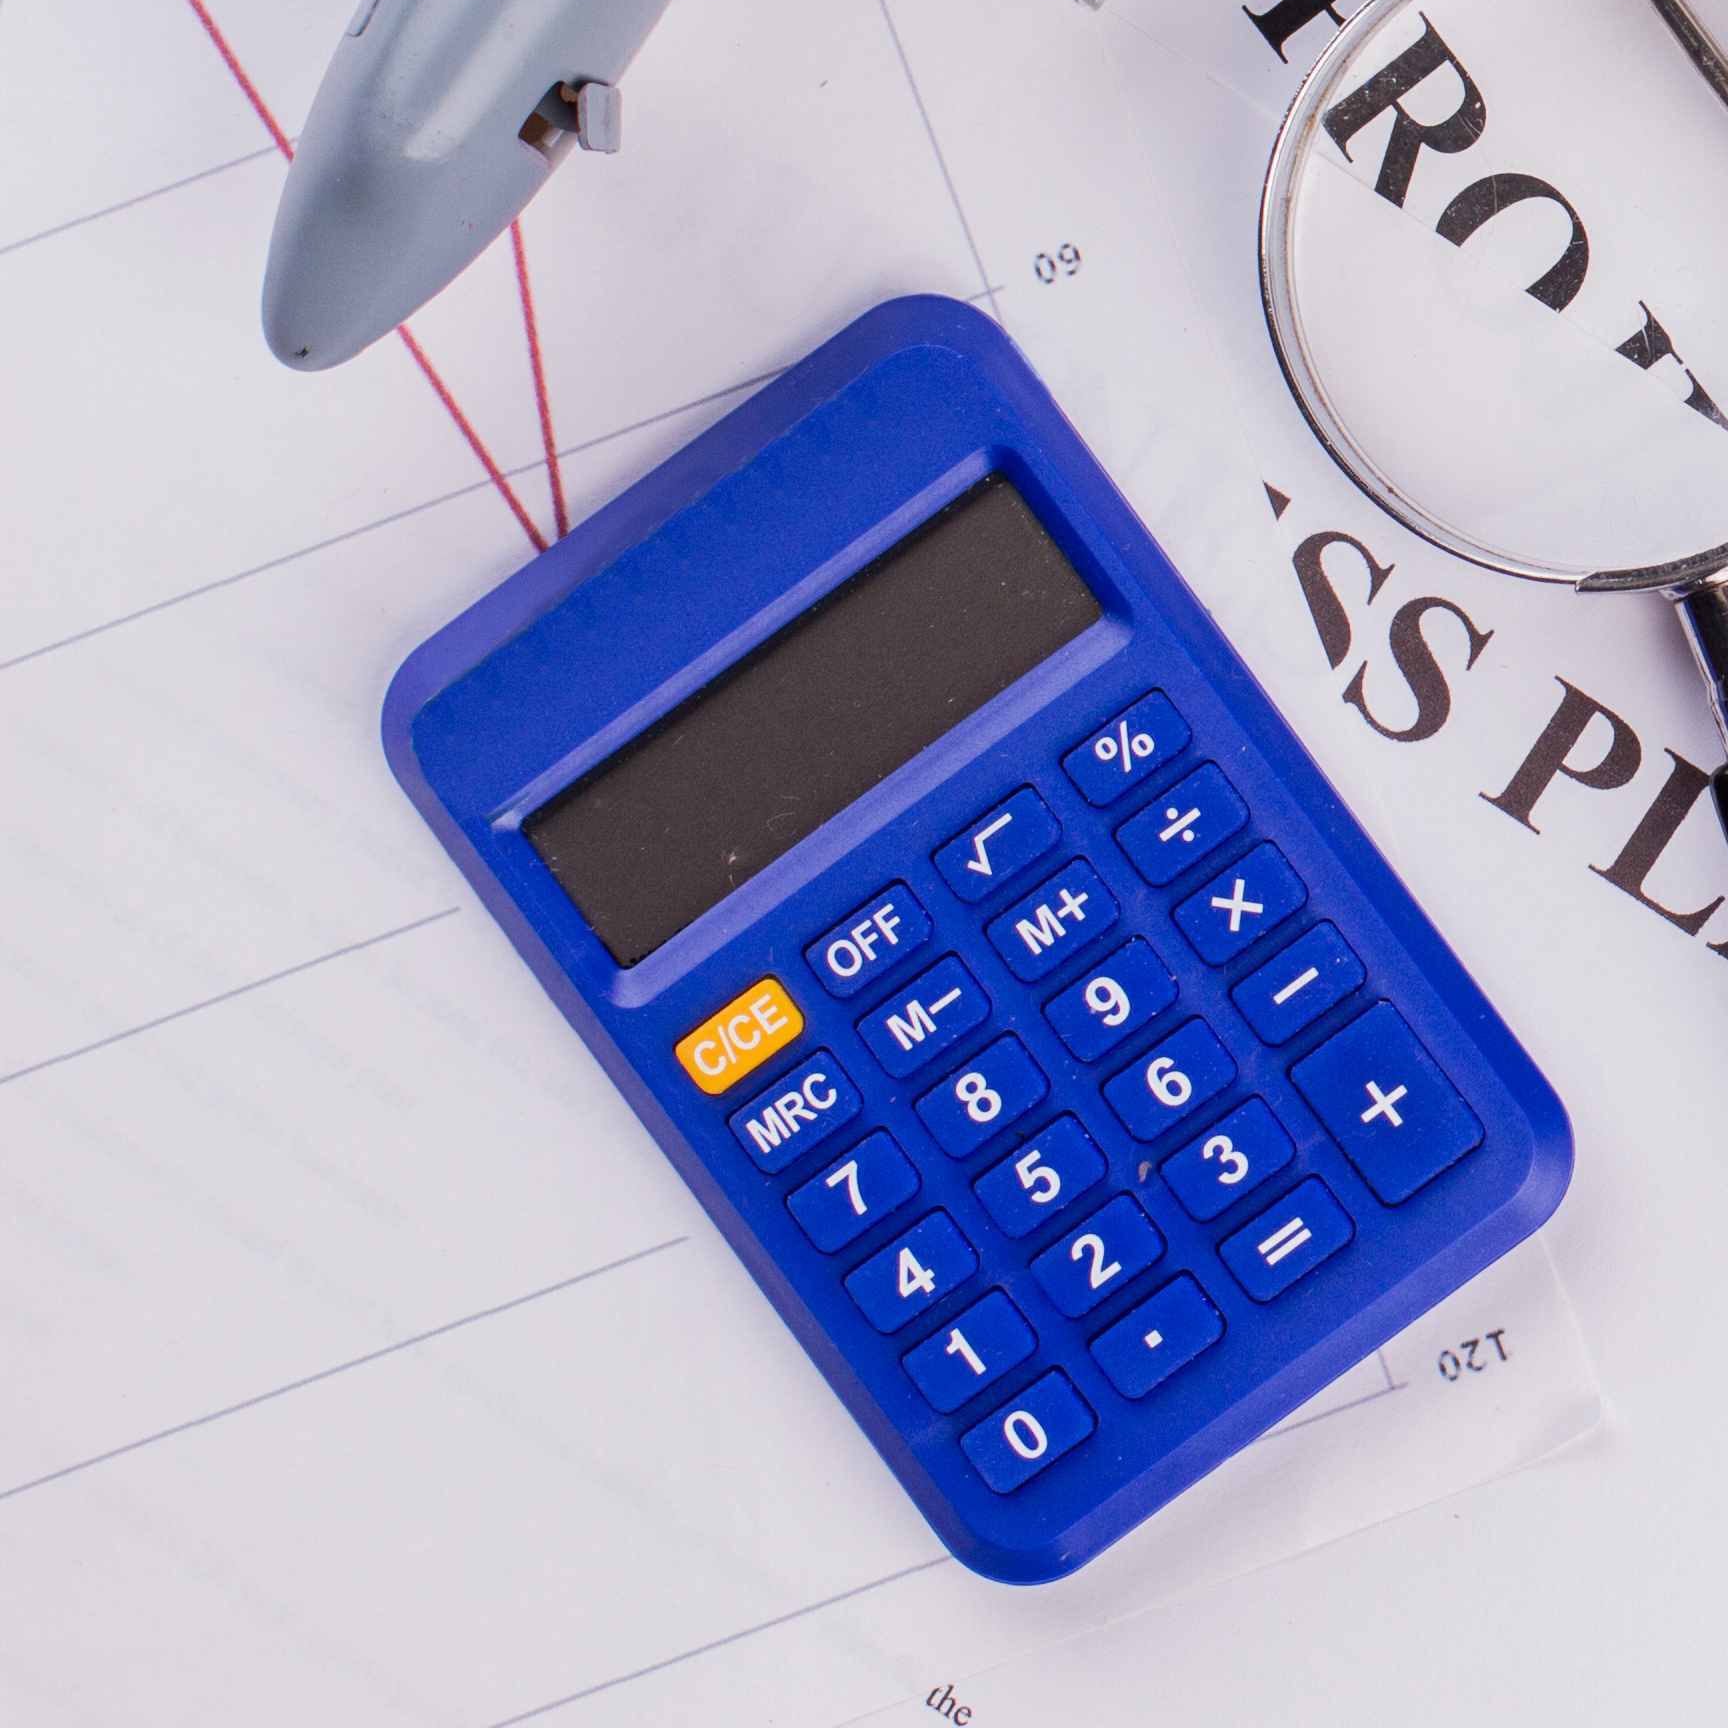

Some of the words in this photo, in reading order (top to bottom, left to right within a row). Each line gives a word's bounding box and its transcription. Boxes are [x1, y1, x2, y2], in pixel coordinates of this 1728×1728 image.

[827, 903, 900, 977] OFF
[1015, 889, 1088, 955] M+
[1085, 977, 1130, 1026] 9
[692, 993, 790, 1077] C/CE
[955, 1072, 1002, 1122] 8
[1147, 1057, 1192, 1106] 6
[746, 1073, 837, 1153] MRC
[1015, 1150, 1061, 1203] 5
[1203, 1135, 1249, 1184] 3
[826, 1161, 867, 1215] 7
[899, 1247, 935, 1298] 4
[1071, 1234, 1121, 1289] 2
[946, 1329, 986, 1375] 1
[1004, 1411, 1047, 1459] 0
